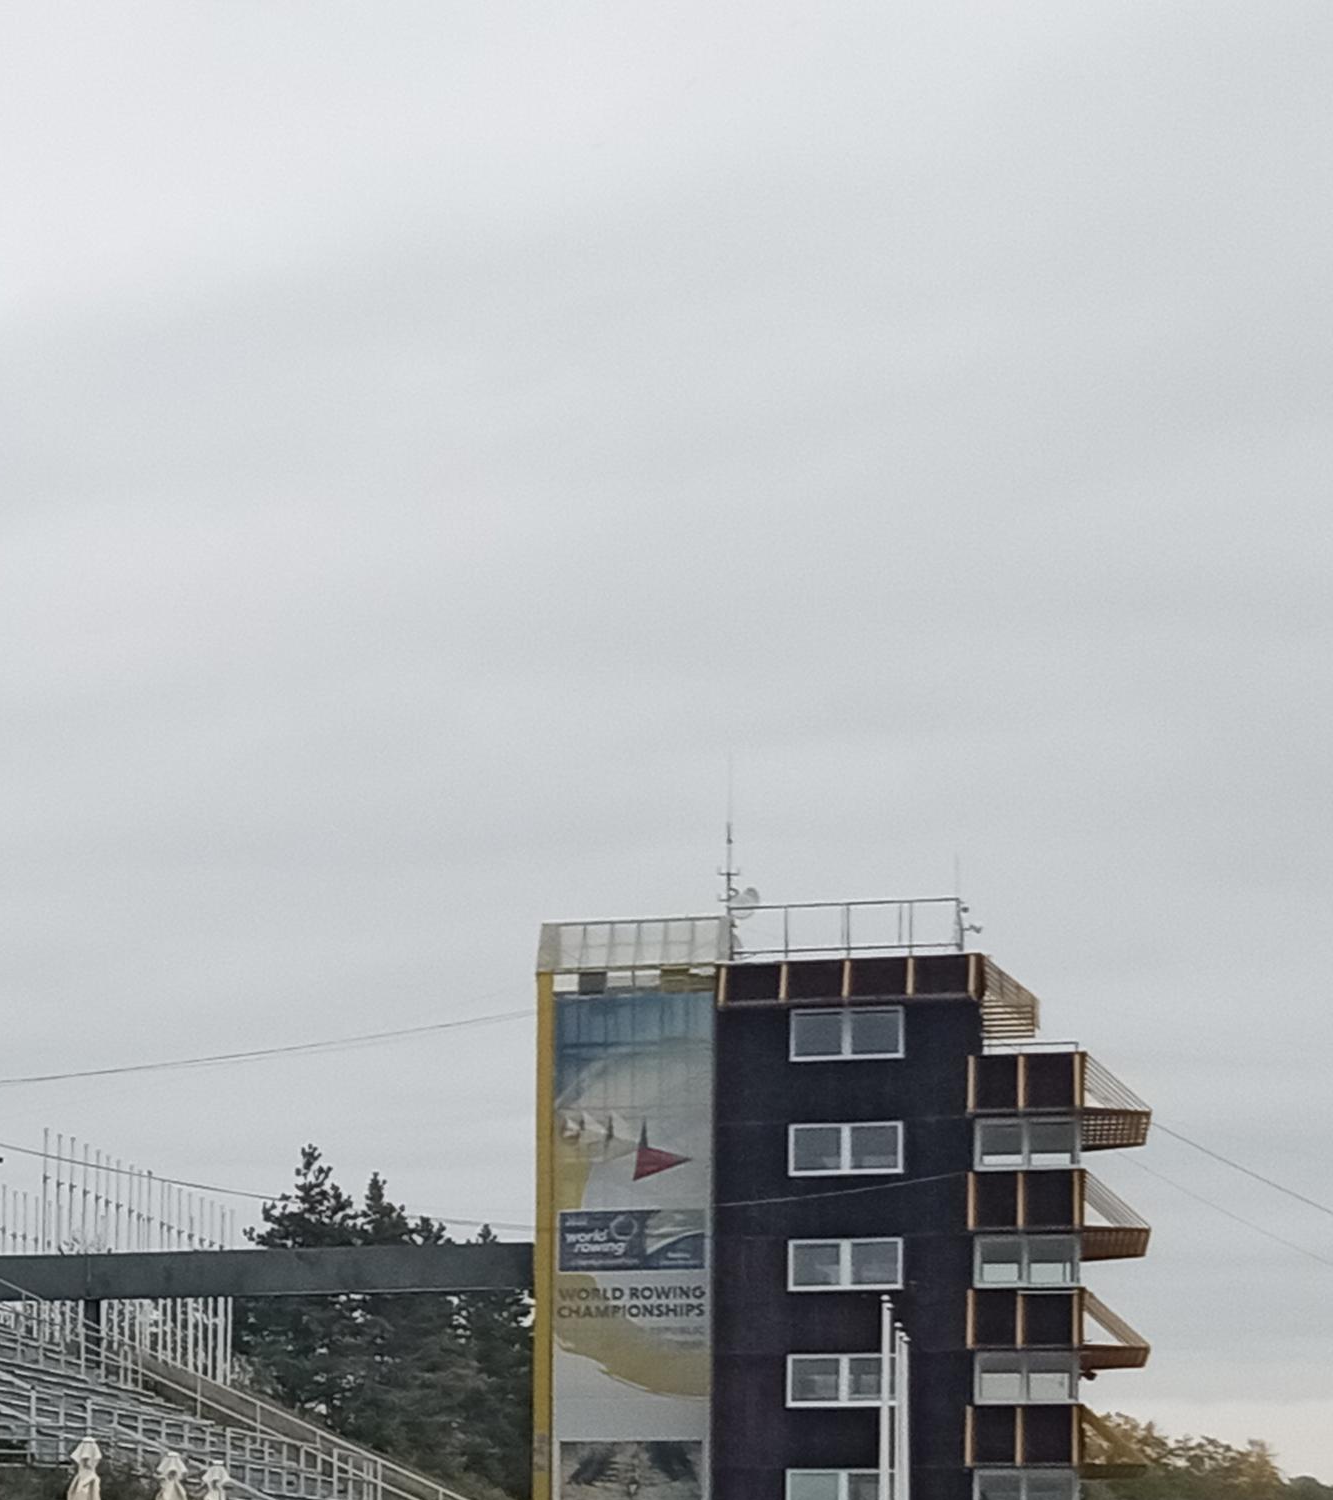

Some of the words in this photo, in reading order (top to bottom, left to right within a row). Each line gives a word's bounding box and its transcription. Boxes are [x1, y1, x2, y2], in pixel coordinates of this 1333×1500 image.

[564, 1229, 609, 1244] world
[573, 1242, 627, 1256] rowing
[558, 1287, 624, 1301] WORLD
[629, 1285, 706, 1300] ROWING
[557, 1303, 705, 1318] CHAMPIONSHIPS
